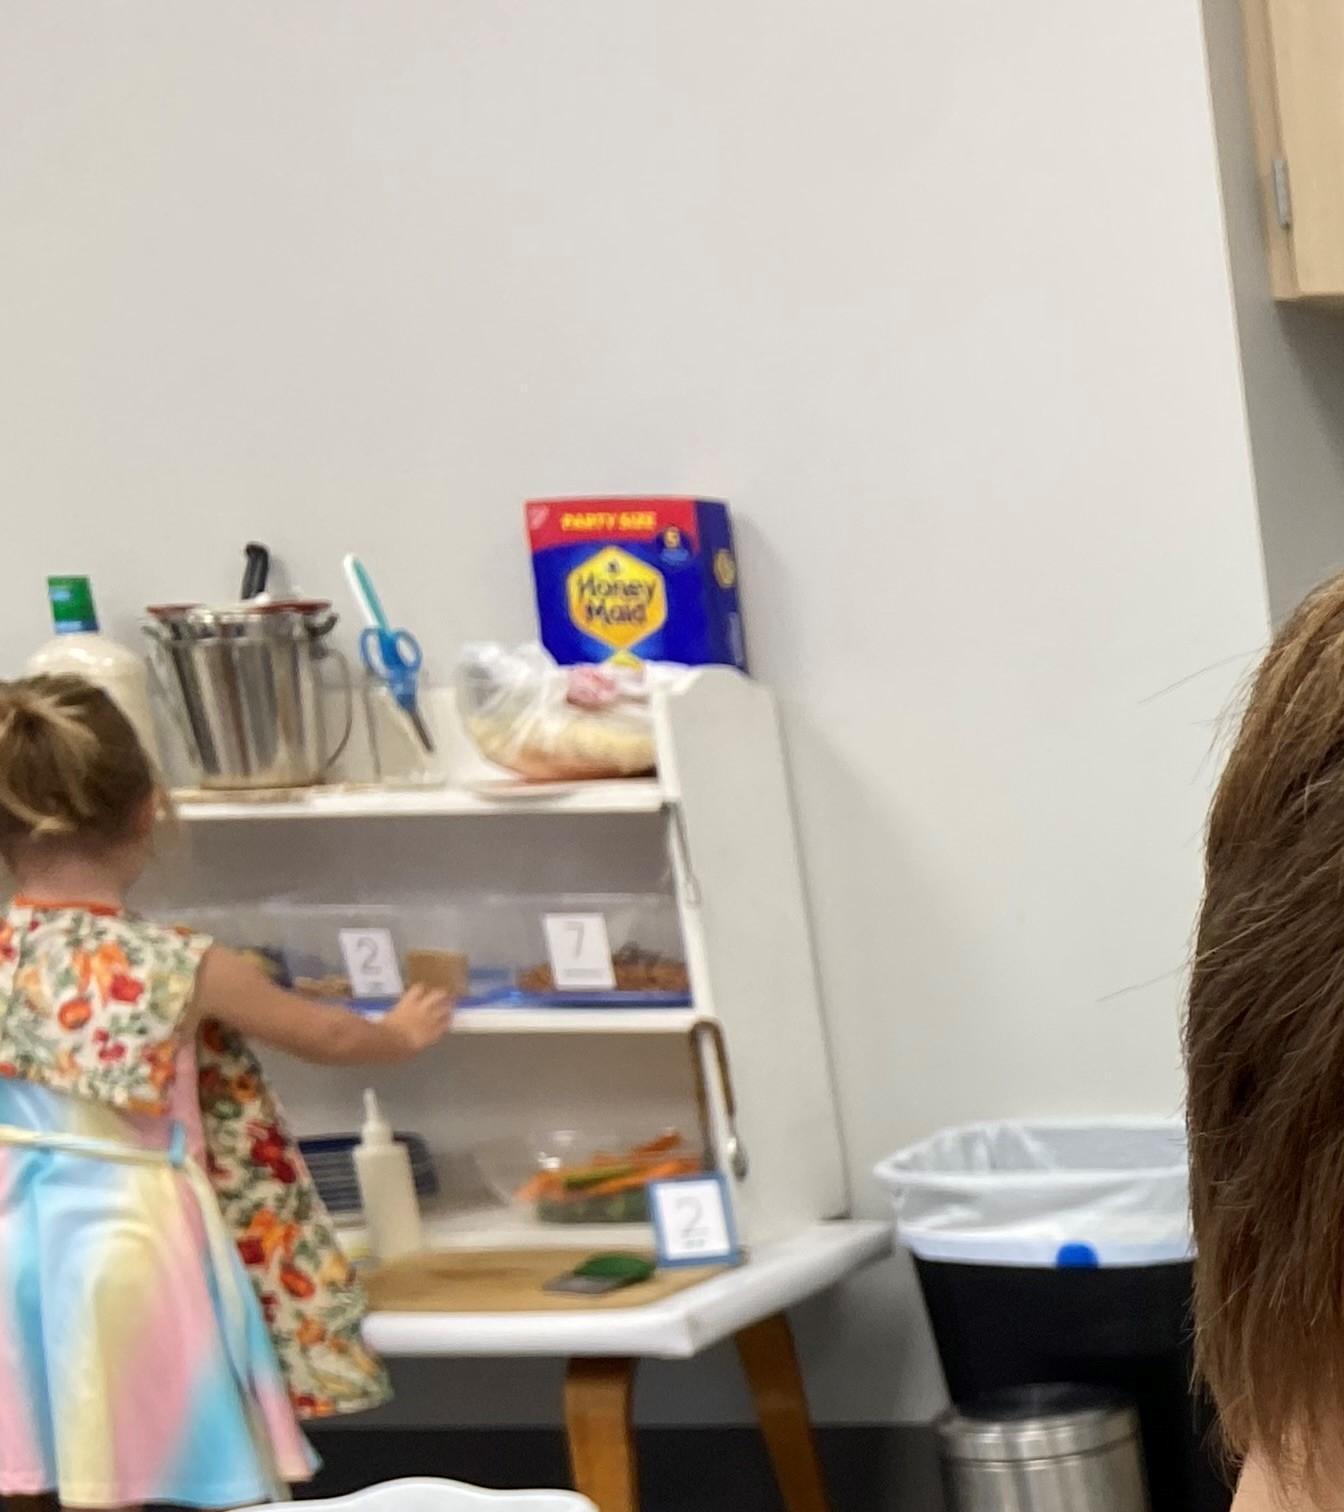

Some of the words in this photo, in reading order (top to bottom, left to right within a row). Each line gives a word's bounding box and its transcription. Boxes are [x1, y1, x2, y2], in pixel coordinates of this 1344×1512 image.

[562, 512, 616, 531] PARTY
[577, 572, 656, 605] Honey
[586, 600, 647, 625] Maid
[355, 936, 383, 976] 2
[563, 920, 585, 961] 7
